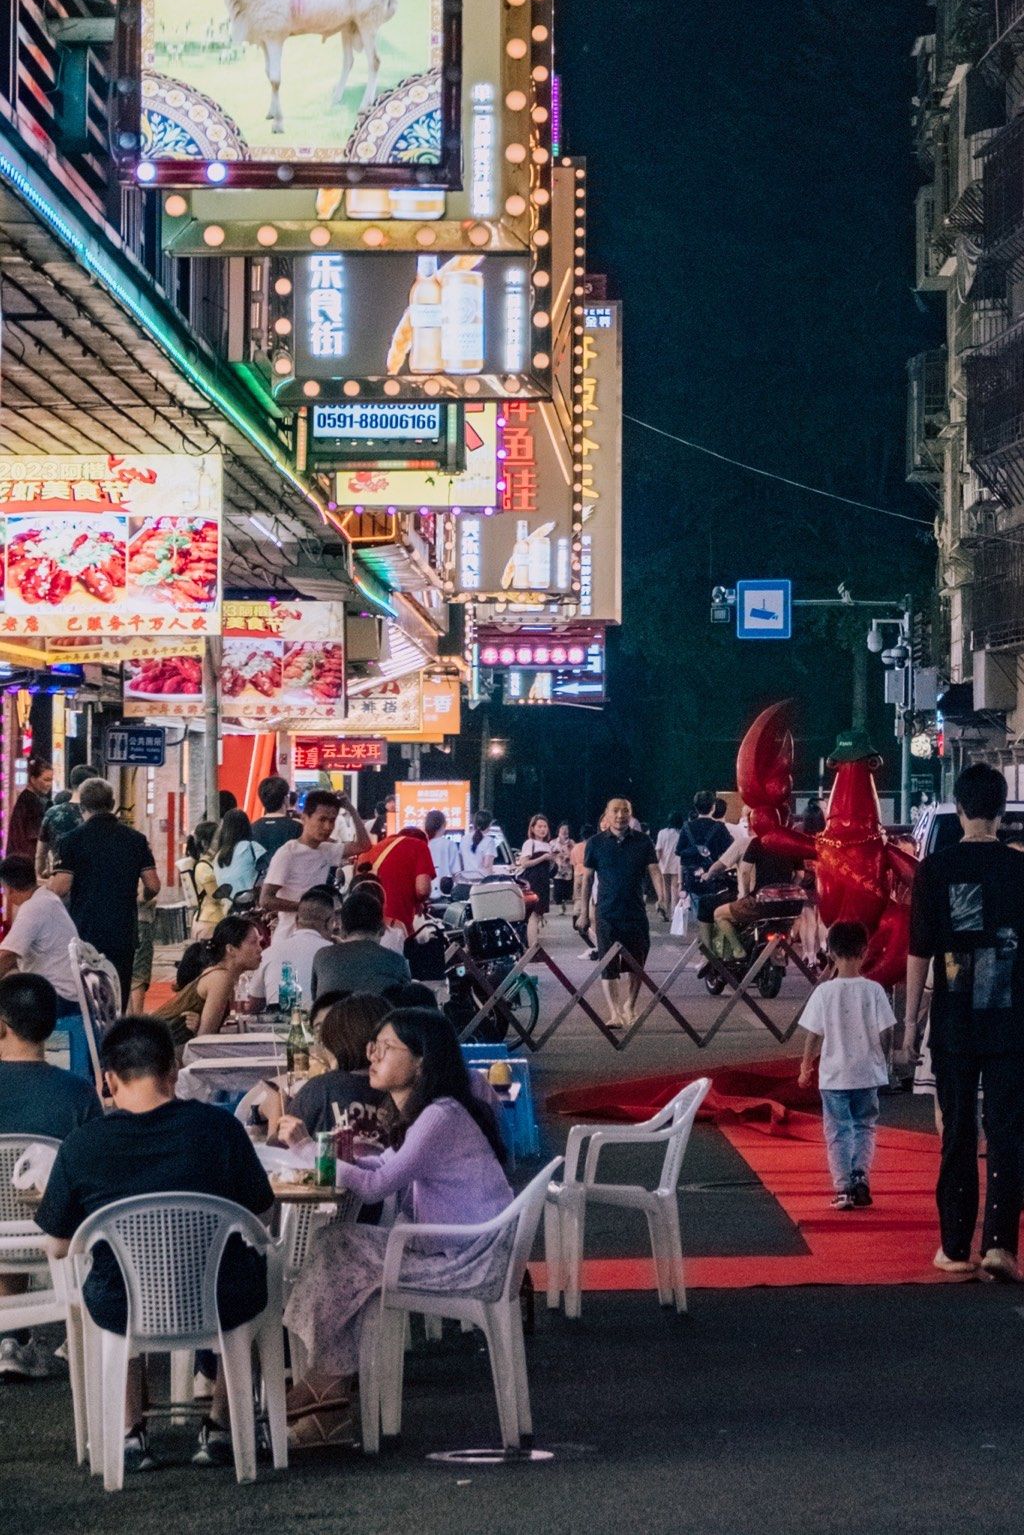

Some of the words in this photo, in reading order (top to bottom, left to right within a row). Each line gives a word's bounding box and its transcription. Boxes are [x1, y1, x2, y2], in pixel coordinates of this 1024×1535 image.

[317, 413, 437, 430] 0591-88006166
[322, 743, 381, 759] 云上采耳
